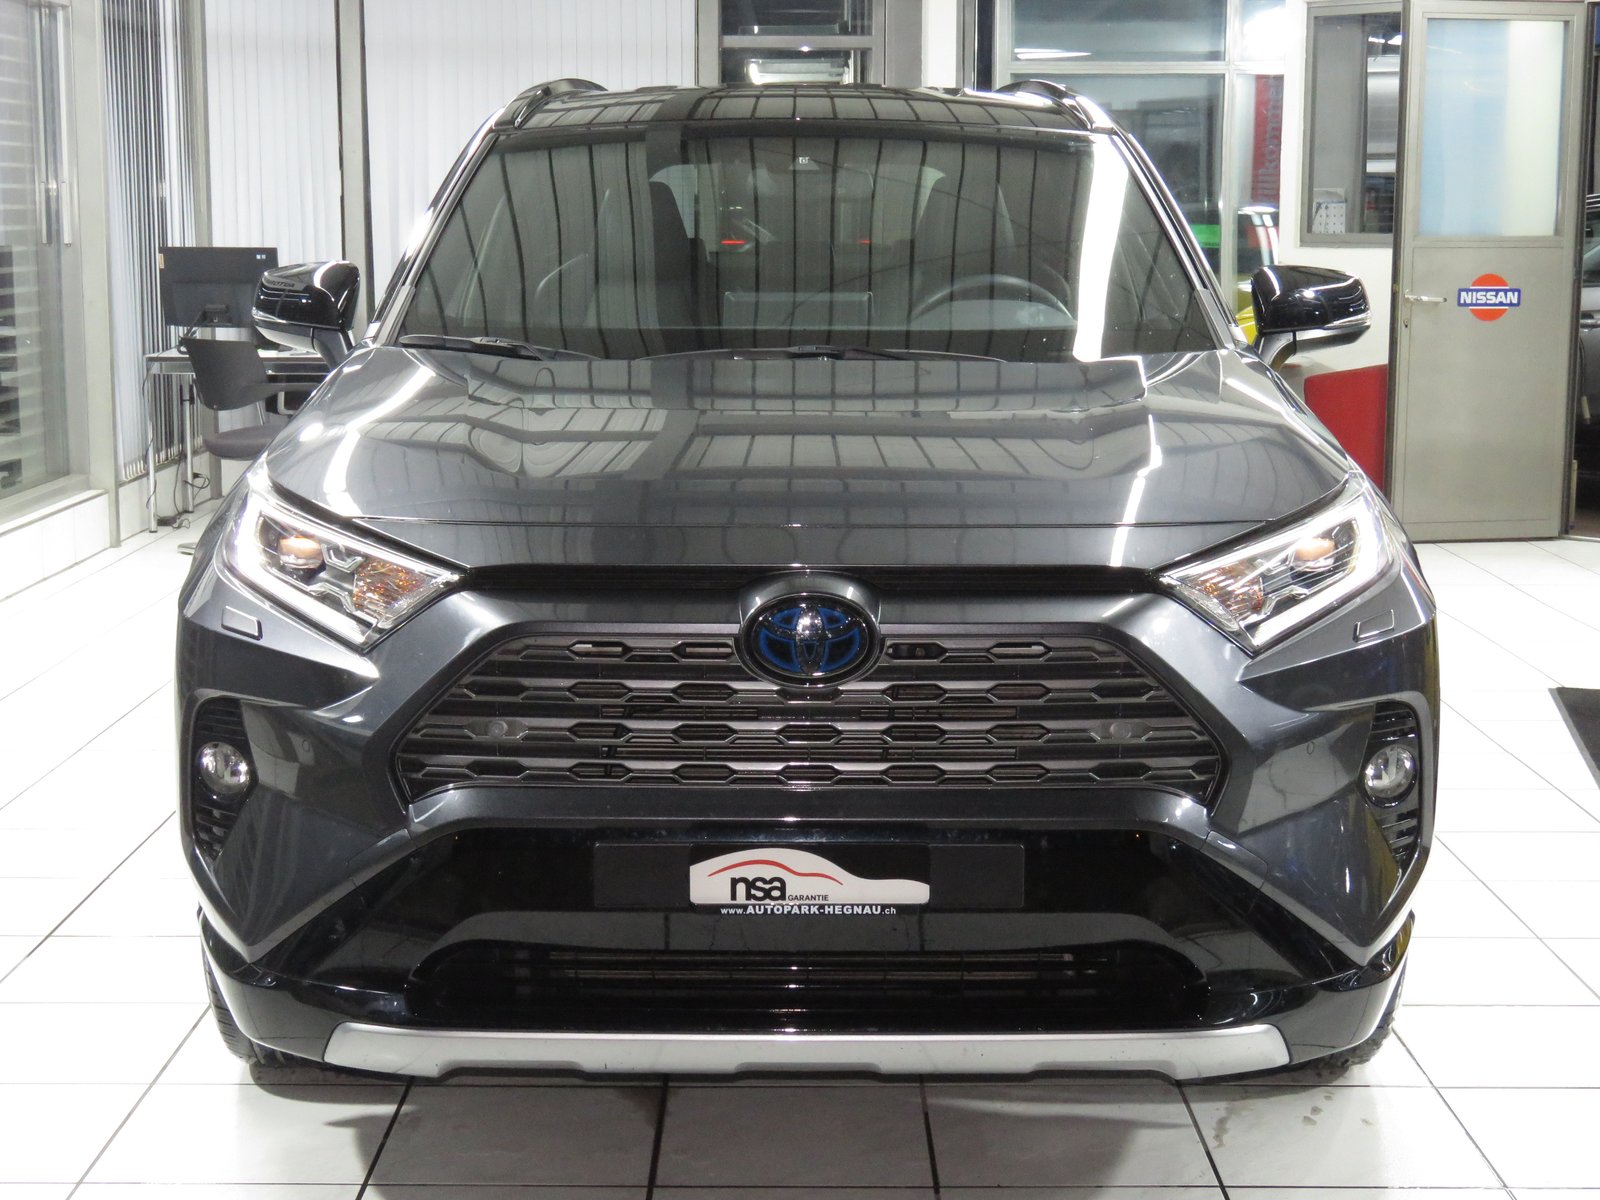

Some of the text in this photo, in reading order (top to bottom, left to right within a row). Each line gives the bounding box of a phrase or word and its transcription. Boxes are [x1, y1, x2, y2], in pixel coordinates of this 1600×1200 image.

[1460, 291, 1519, 304] NISSAN
[730, 876, 786, 902] nsa
[787, 894, 829, 902] GARANTIE
[720, 904, 896, 915] www.AUTOPARK-HEGNAU.ch
